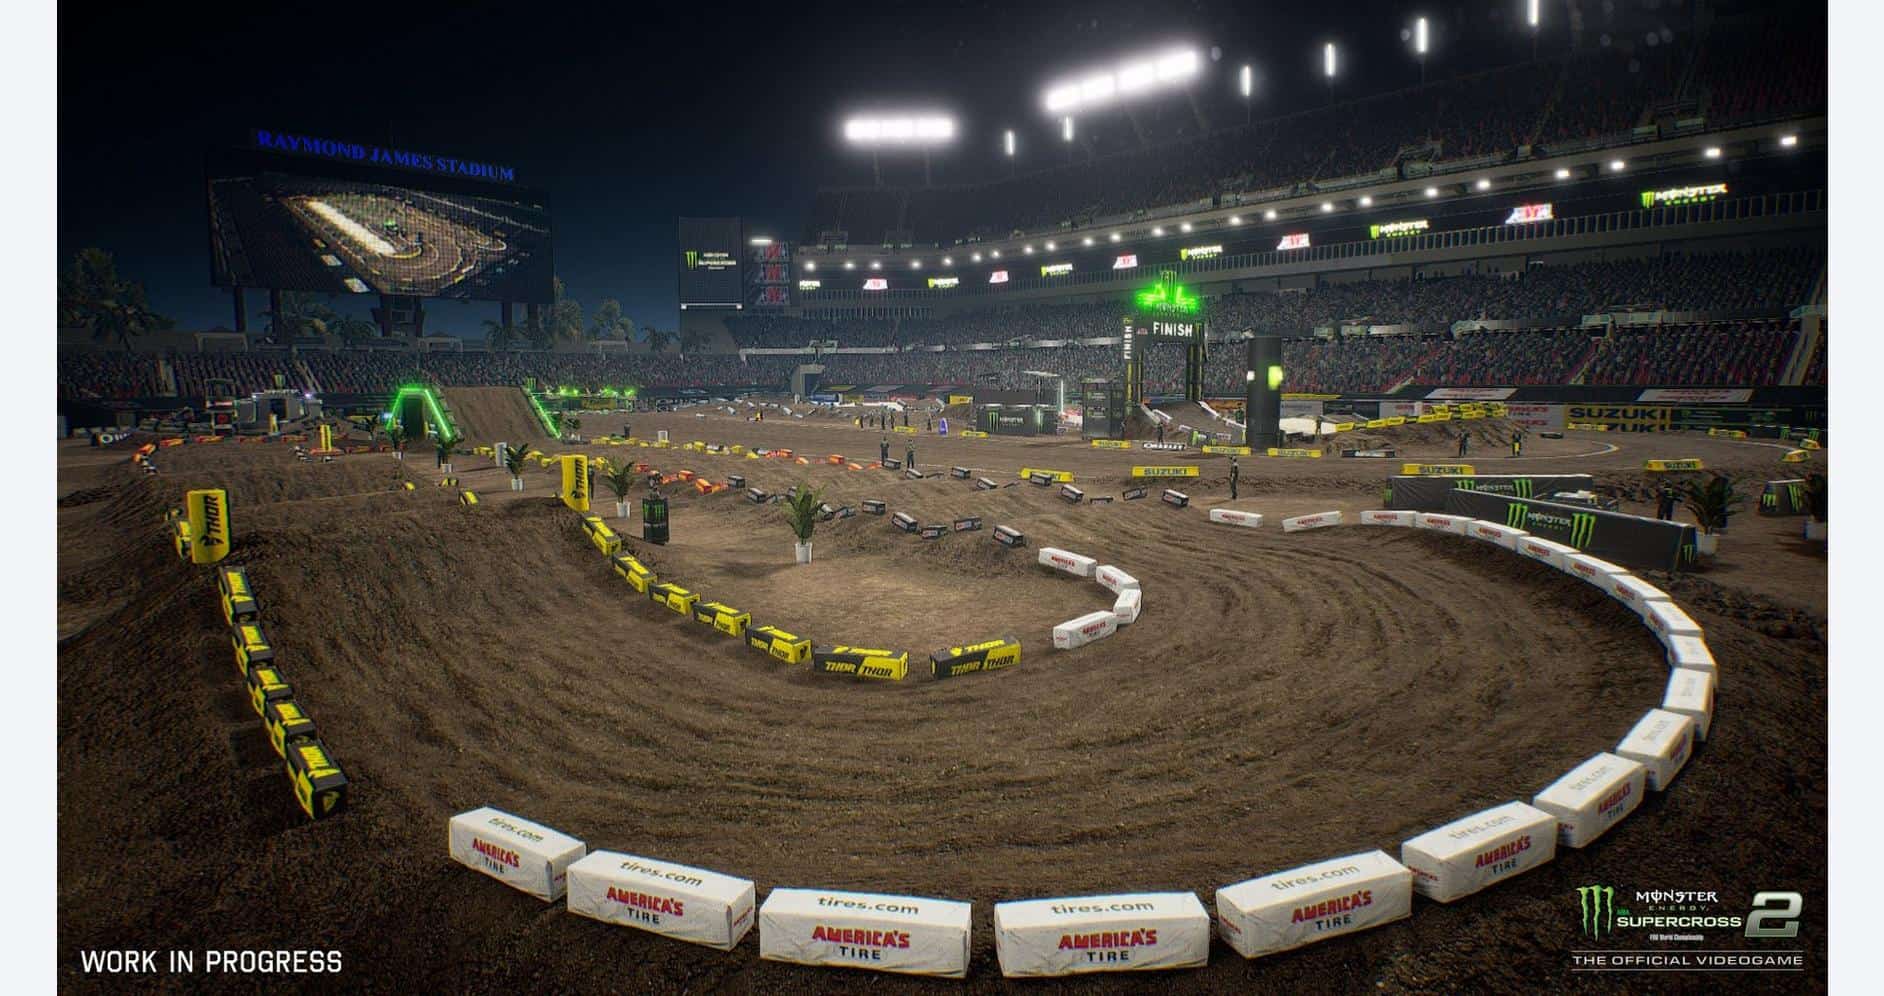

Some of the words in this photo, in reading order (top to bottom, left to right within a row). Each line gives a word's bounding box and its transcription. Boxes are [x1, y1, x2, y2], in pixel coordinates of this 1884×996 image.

[257, 129, 365, 160] RAYMOND
[370, 146, 433, 170] JAMES
[436, 157, 514, 181] STADIUM
[1153, 321, 1193, 337] FINISH
[1124, 326, 1133, 360] FINISH
[1569, 407, 1667, 420] SUZUKI
[1144, 466, 1188, 476] SUZUKI
[1419, 465, 1463, 475] SUZUKI
[204, 495, 221, 533] THOR
[825, 661, 857, 673] THOR
[862, 665, 893, 677] THOR
[951, 660, 981, 676] THOR
[987, 655, 1015, 668] THOR
[488, 817, 544, 842] tires.com
[472, 837, 520, 868] AMERICA'S
[485, 857, 505, 874] TIRE
[620, 861, 703, 887] tires.com
[1492, 858, 1518, 875] TIRE
[1271, 864, 1361, 890] tires.com
[606, 886, 684, 917] AMERICA'S
[818, 897, 919, 915] tires.com
[1051, 902, 1154, 915] tires.com
[1291, 889, 1373, 924] AMERICA'S
[627, 907, 660, 924] TIRE
[1315, 914, 1352, 931] TIRE
[812, 926, 910, 949] AMERICA'S
[1058, 928, 1157, 950] AMERICA'S
[839, 946, 881, 960] TIRE
[1087, 950, 1130, 962] TIRE
